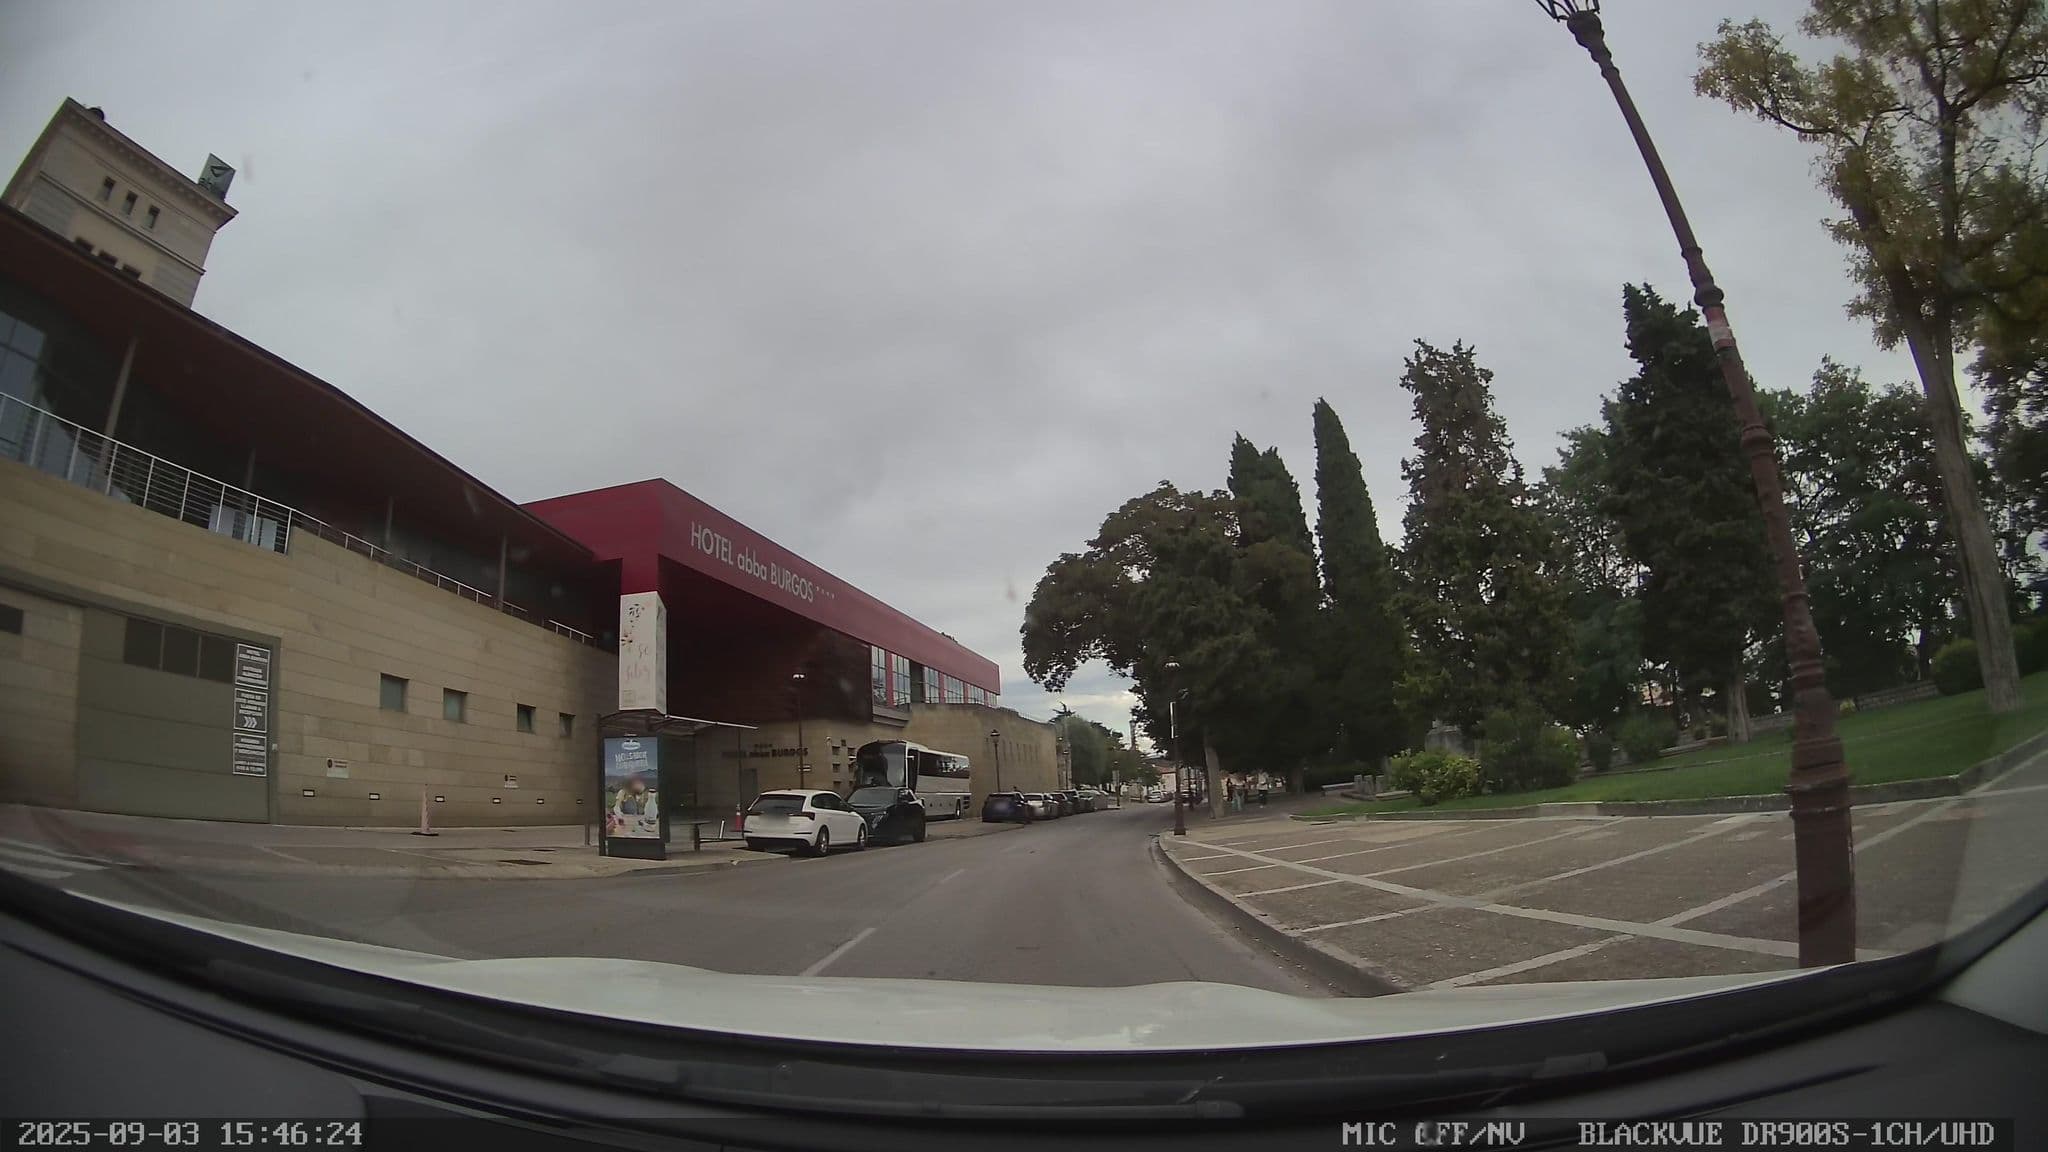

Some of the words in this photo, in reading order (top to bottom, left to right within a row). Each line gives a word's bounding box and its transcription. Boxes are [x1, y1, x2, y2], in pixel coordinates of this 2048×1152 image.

[690, 521, 734, 566] HOTEL
[737, 546, 768, 582] abba
[770, 562, 814, 602] BURGOS
